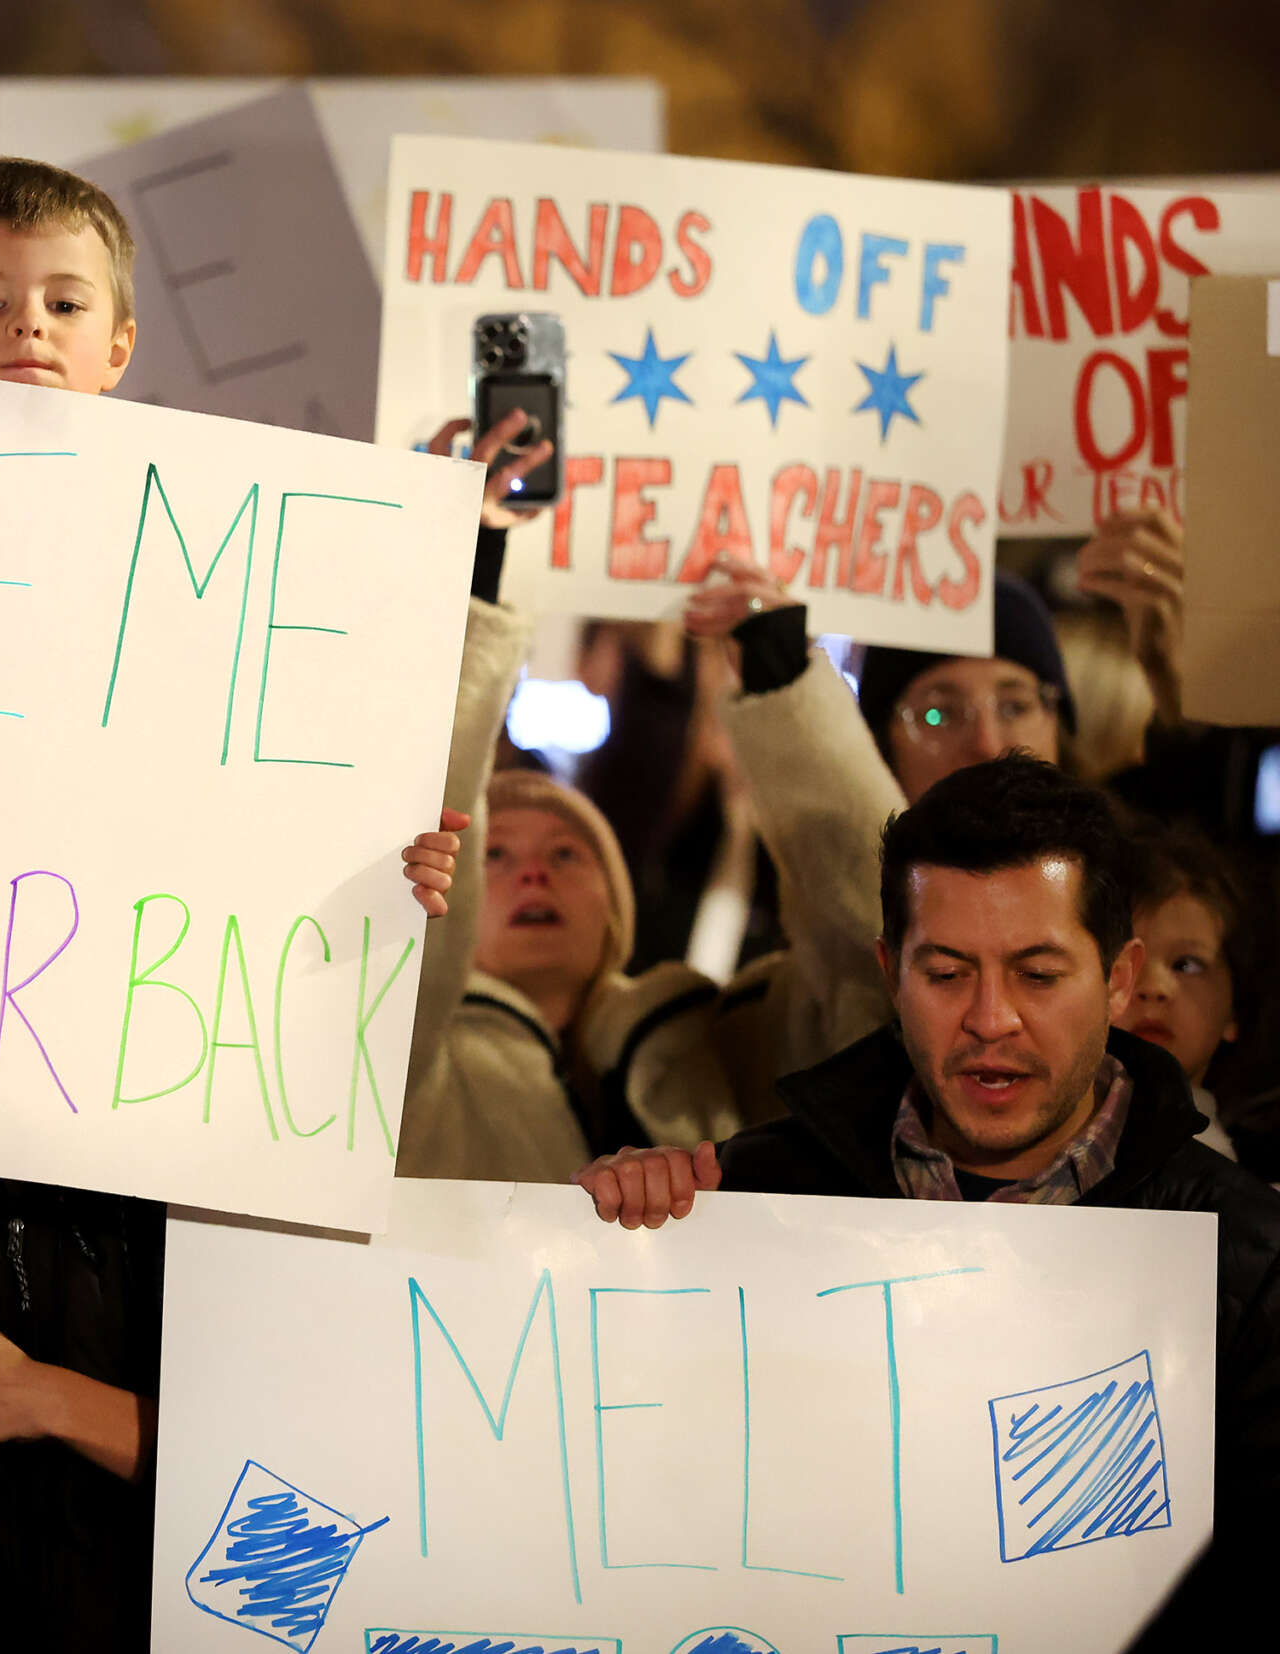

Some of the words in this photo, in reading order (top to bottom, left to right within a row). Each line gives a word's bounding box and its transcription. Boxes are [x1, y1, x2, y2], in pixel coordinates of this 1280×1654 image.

[404, 189, 714, 299] HANDS
[793, 213, 966, 332] OFF
[1074, 346, 1189, 474] OF
[550, 456, 987, 612] TEACHERS
[997, 457, 1065, 525] UR
[102, 462, 403, 768] ME
[112, 892, 417, 1158] BACK
[408, 1267, 986, 1604] MELT
